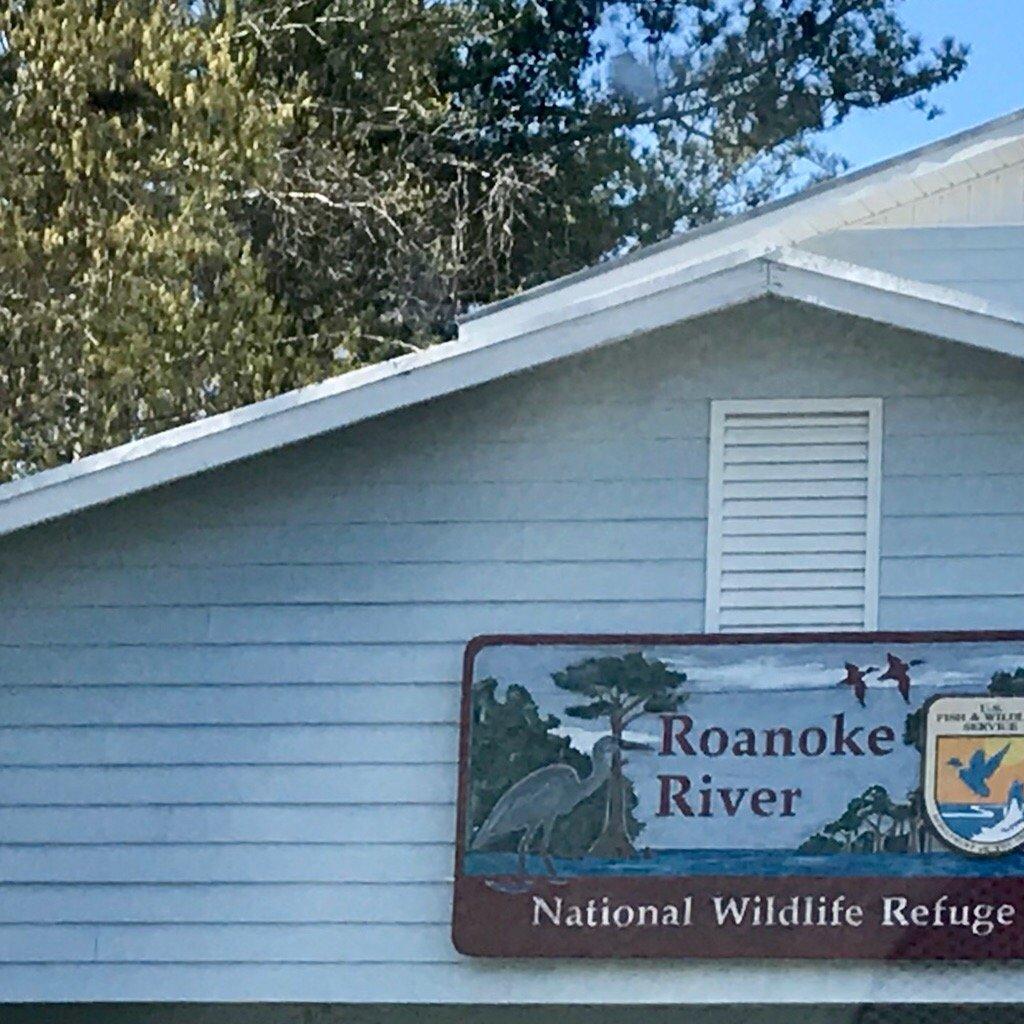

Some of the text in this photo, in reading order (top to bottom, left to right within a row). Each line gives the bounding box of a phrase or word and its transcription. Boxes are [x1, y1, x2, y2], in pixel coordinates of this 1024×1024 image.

[658, 712, 896, 757] Roanoke
[655, 773, 803, 818] River
[531, 896, 1017, 936] National Wildlife Refuge
